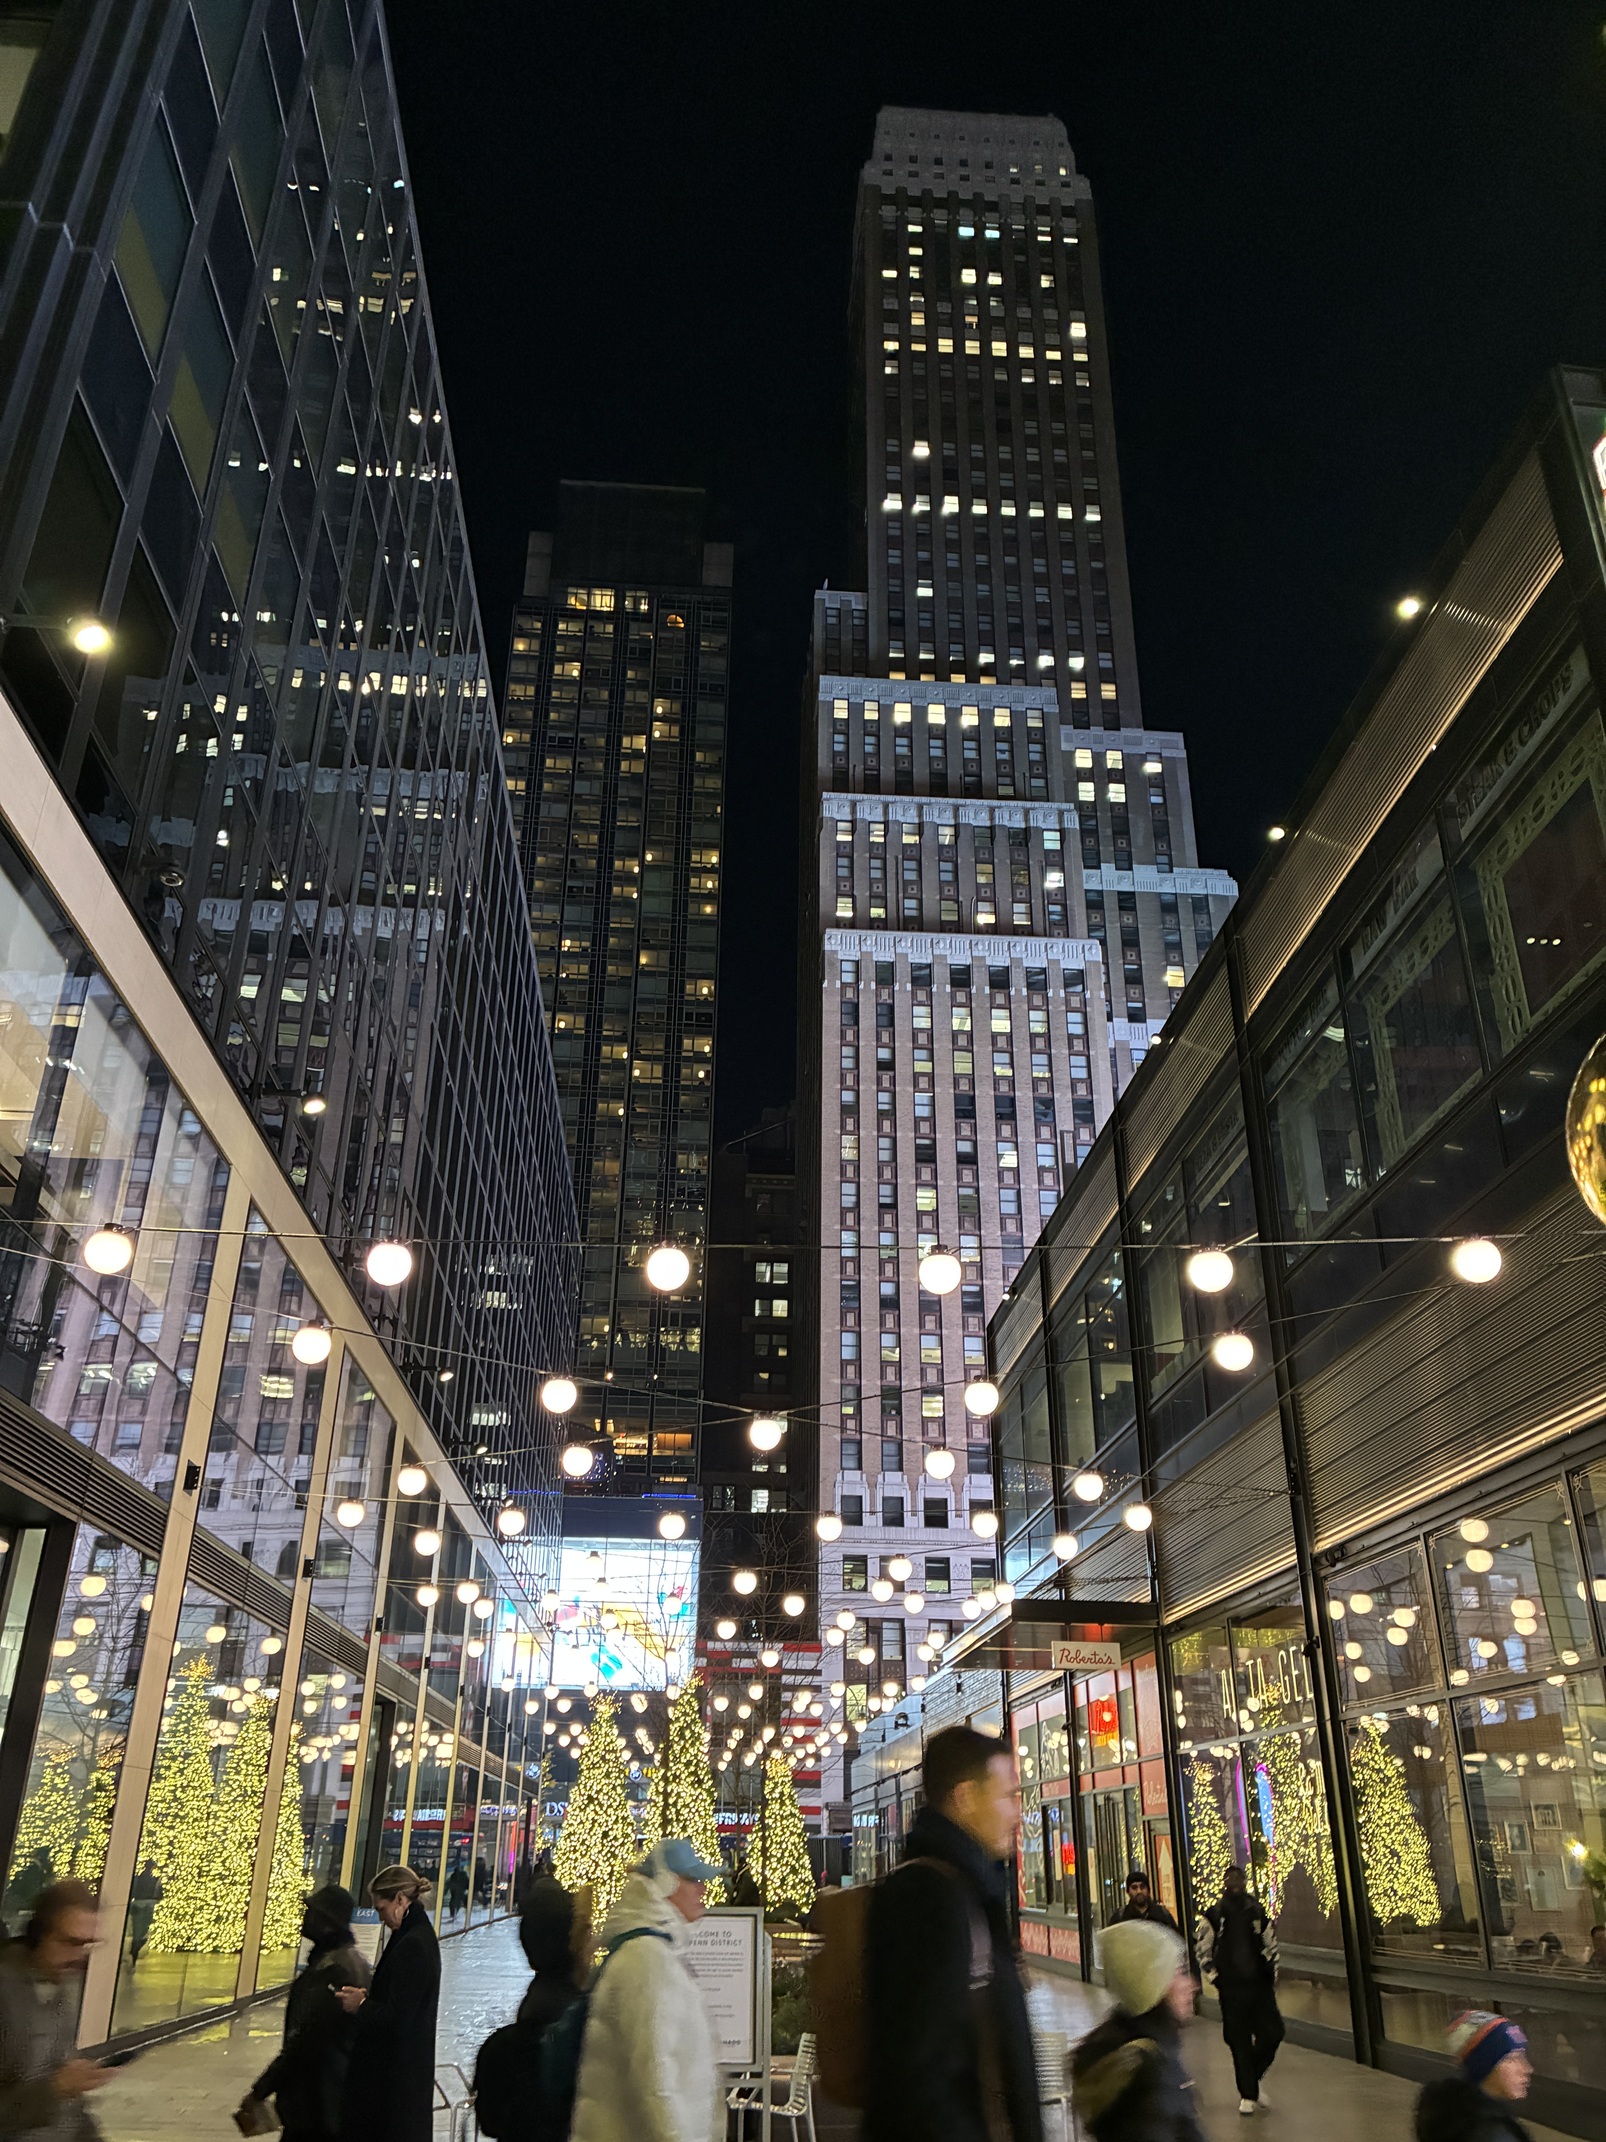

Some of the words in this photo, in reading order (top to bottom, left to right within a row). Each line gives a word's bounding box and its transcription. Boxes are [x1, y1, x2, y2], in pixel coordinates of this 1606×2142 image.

[1519, 662, 1573, 747] CHOPS
[1059, 1647, 1116, 1665] Roberta's
[545, 1801, 569, 1817] DS
[356, 1909, 375, 1917] EAST
[722, 1930, 732, 1938] TO
[710, 1938, 743, 1947] DISTRICT
